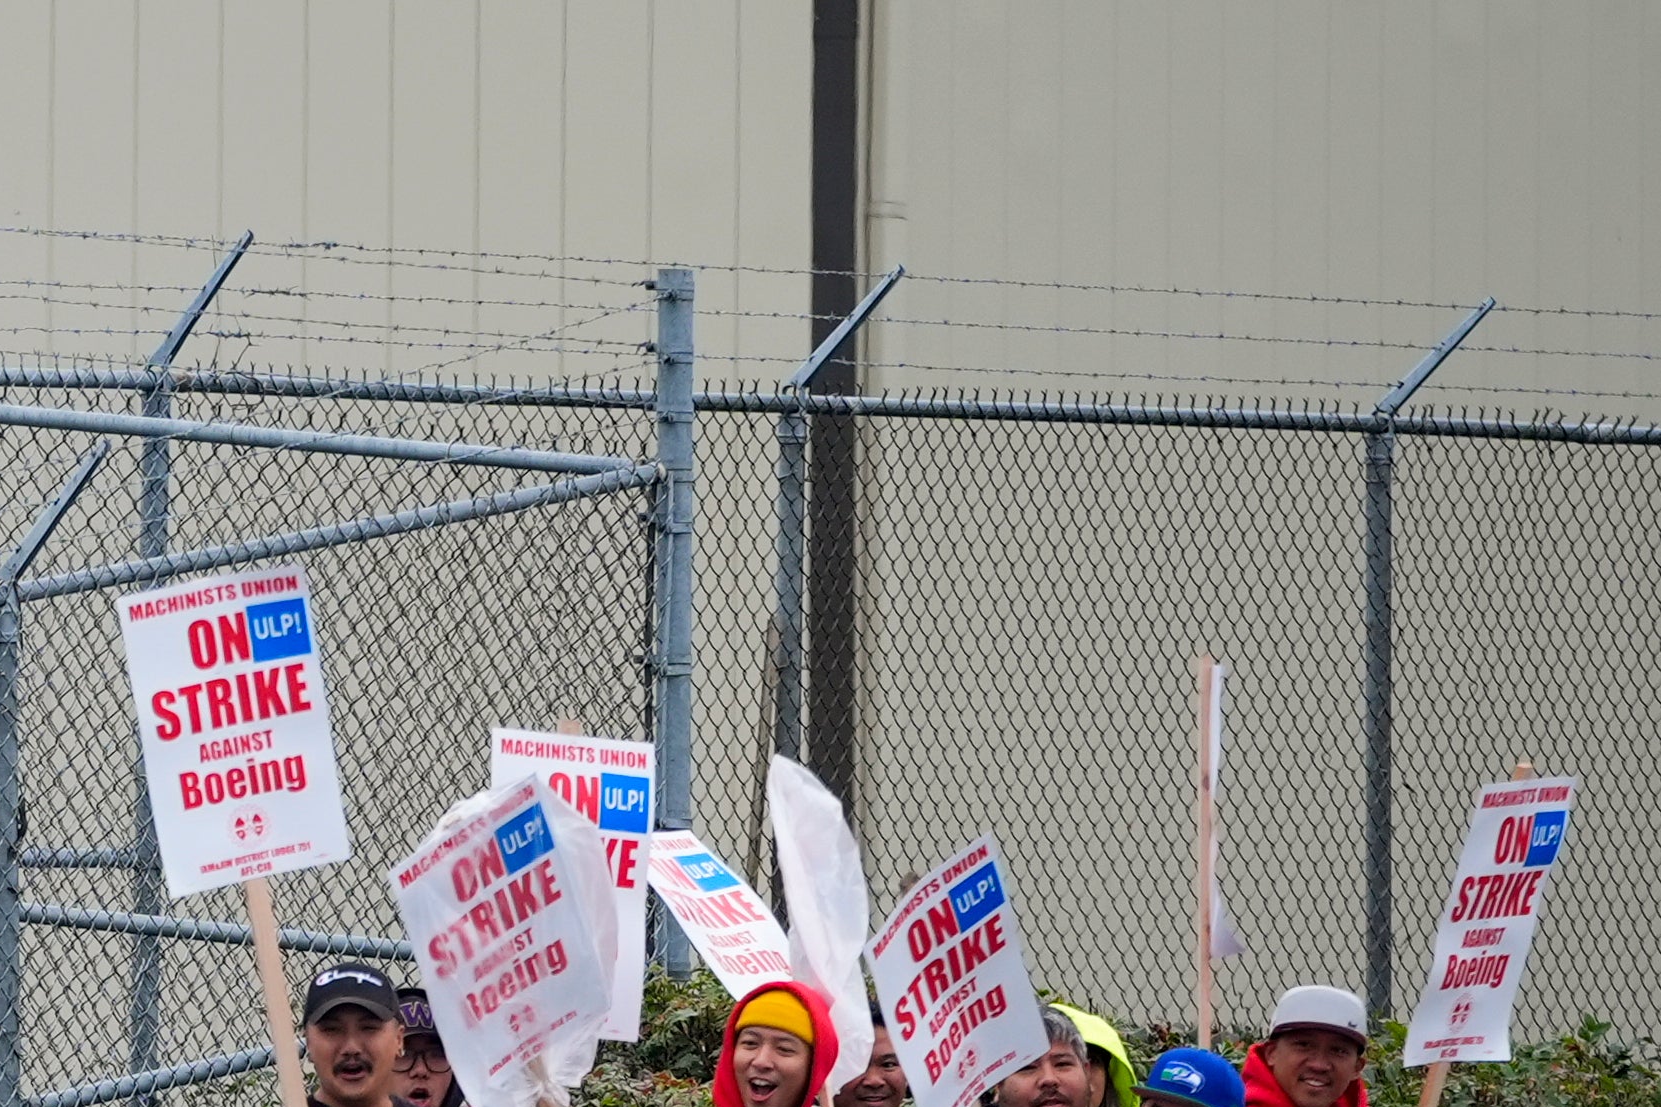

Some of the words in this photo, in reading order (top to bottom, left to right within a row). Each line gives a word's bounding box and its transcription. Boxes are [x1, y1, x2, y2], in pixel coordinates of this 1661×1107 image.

[128, 584, 237, 622] MACHINISTS
[241, 575, 298, 597] UNION
[188, 611, 252, 670] ON
[253, 612, 303, 640] ULP!
[152, 663, 312, 742] STRIKE
[199, 729, 273, 764] AGAINST
[501, 738, 595, 764] MACHINISTS
[599, 749, 647, 769] UNION
[179, 755, 307, 811] Boeing
[549, 772, 600, 825] ON
[604, 786, 645, 814] ULP!
[1538, 786, 1570, 803] UNION
[451, 836, 506, 904] ON
[501, 815, 545, 855] ULP!
[1494, 815, 1534, 865] ON
[1532, 824, 1562, 848] ULP!
[683, 861, 725, 880] ULP!
[1450, 870, 1544, 923] STRIKE
[428, 858, 562, 978] STRIKE
[659, 890, 767, 930] STRIKE
[873, 877, 940, 960] MACHINISTS
[942, 843, 989, 885] UNION
[908, 897, 959, 963] ON
[956, 875, 996, 914] ULP!
[894, 913, 1006, 1042] STRIKE
[1439, 950, 1511, 990] Boeing
[400, 1001, 435, 1029] W
[929, 976, 978, 1039] AGAINST
[924, 984, 1007, 1086] Boeing
